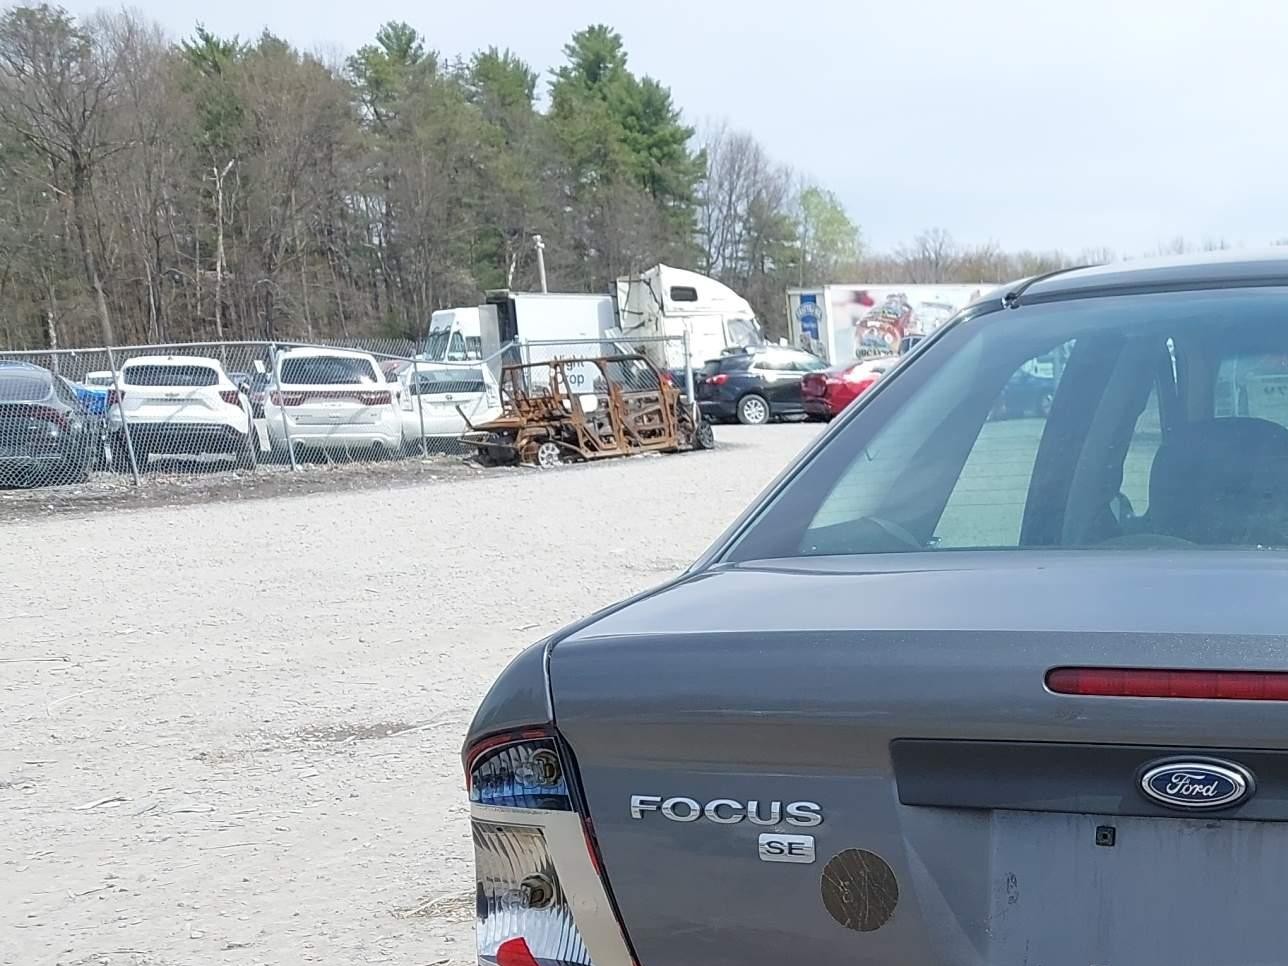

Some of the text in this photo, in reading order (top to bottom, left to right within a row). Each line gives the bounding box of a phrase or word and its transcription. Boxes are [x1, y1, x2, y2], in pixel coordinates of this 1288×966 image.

[556, 371, 585, 387] Dop
[1166, 772, 1218, 797] Ford
[630, 794, 824, 827] FOCUS
[765, 840, 806, 856] SE
